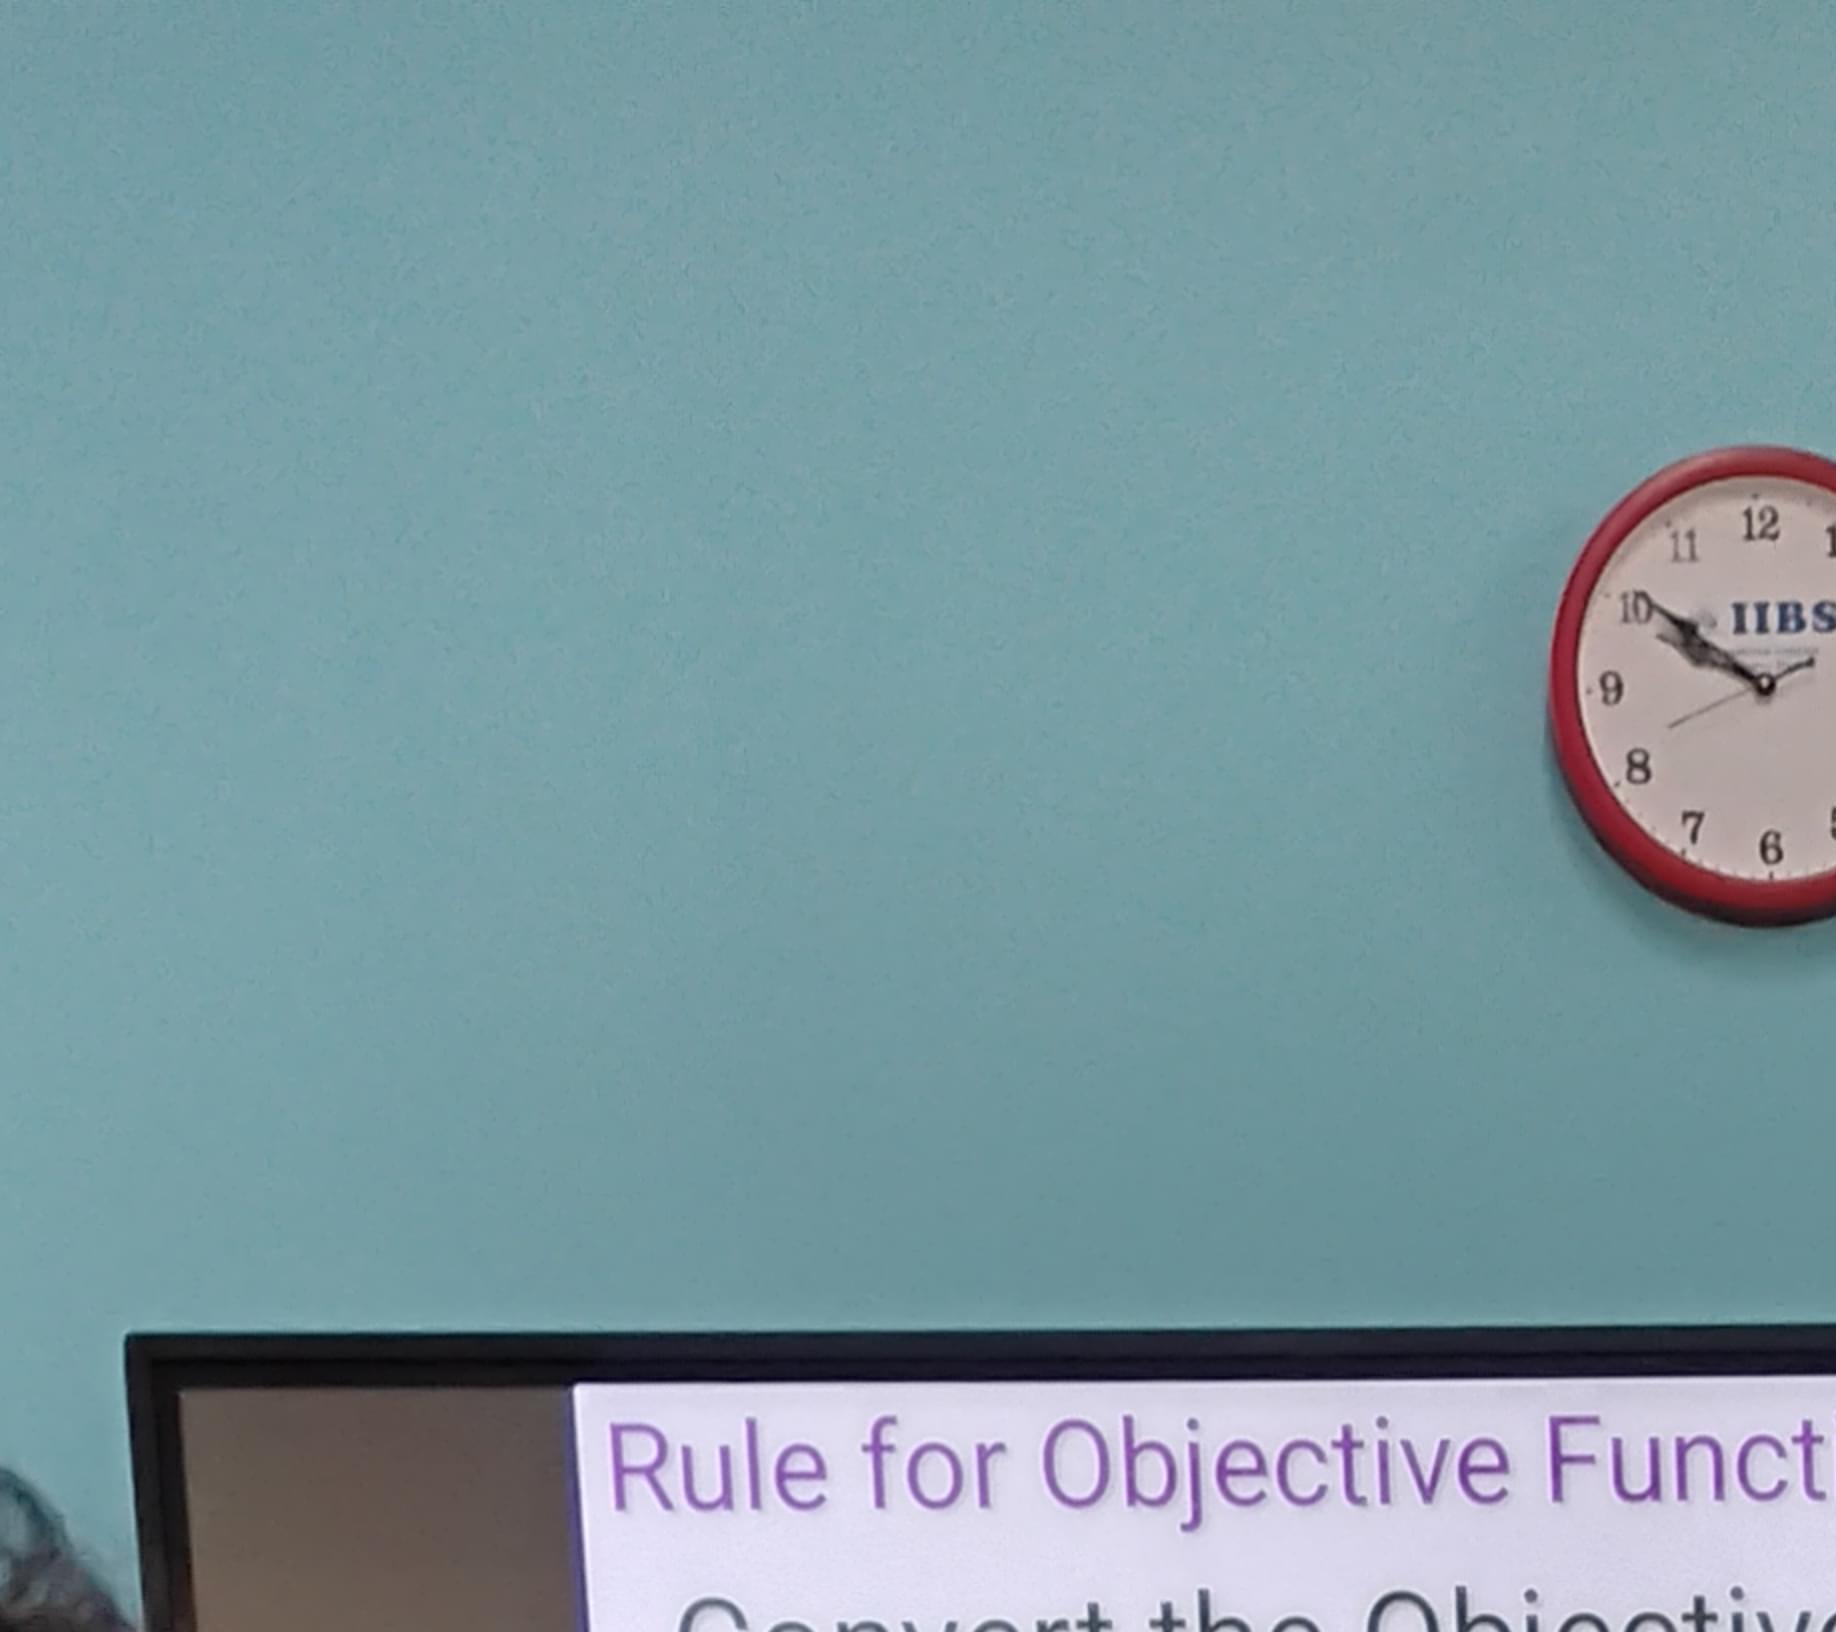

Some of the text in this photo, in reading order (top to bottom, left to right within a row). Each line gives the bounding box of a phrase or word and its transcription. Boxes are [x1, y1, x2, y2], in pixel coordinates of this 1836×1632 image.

[1742, 505, 1780, 541] 12
[1669, 530, 1701, 564] 11
[1620, 590, 1655, 624] 10
[1600, 671, 1624, 706] 9
[1625, 749, 1652, 785] 8
[1681, 811, 1705, 845] 7
[1760, 831, 1784, 866] 6
[608, 1418, 828, 1511] Rule
[862, 1415, 1007, 1510] for
[1043, 1414, 1511, 1532] Objective
